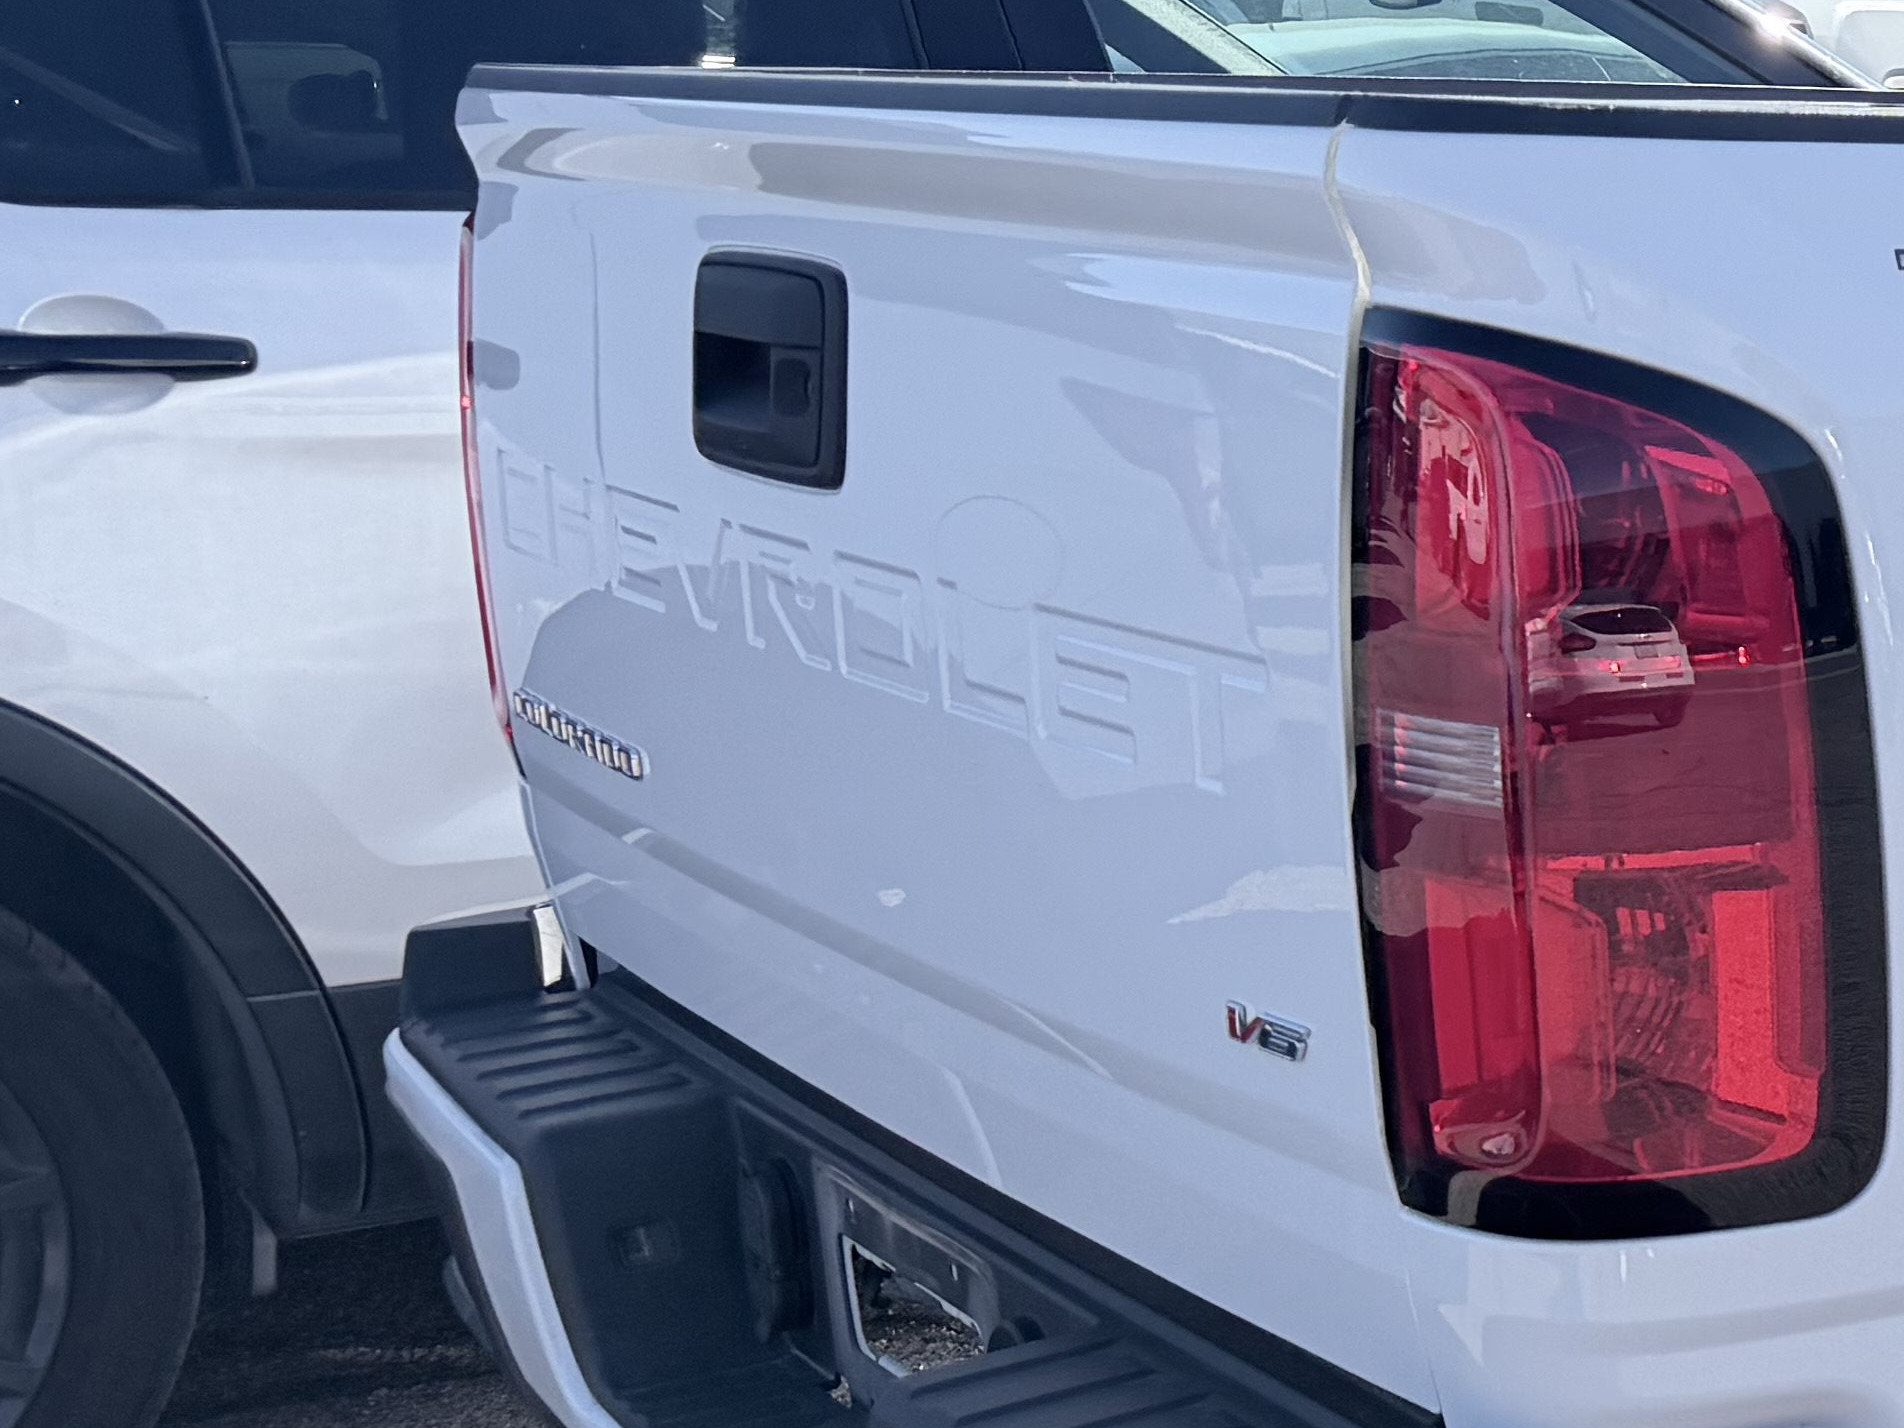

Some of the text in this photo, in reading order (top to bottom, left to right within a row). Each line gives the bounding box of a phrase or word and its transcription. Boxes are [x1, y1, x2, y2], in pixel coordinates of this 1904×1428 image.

[496, 446, 1271, 796] CHEVROLET
[513, 687, 646, 782] COLORADO
[1225, 999, 1312, 1062] V6
